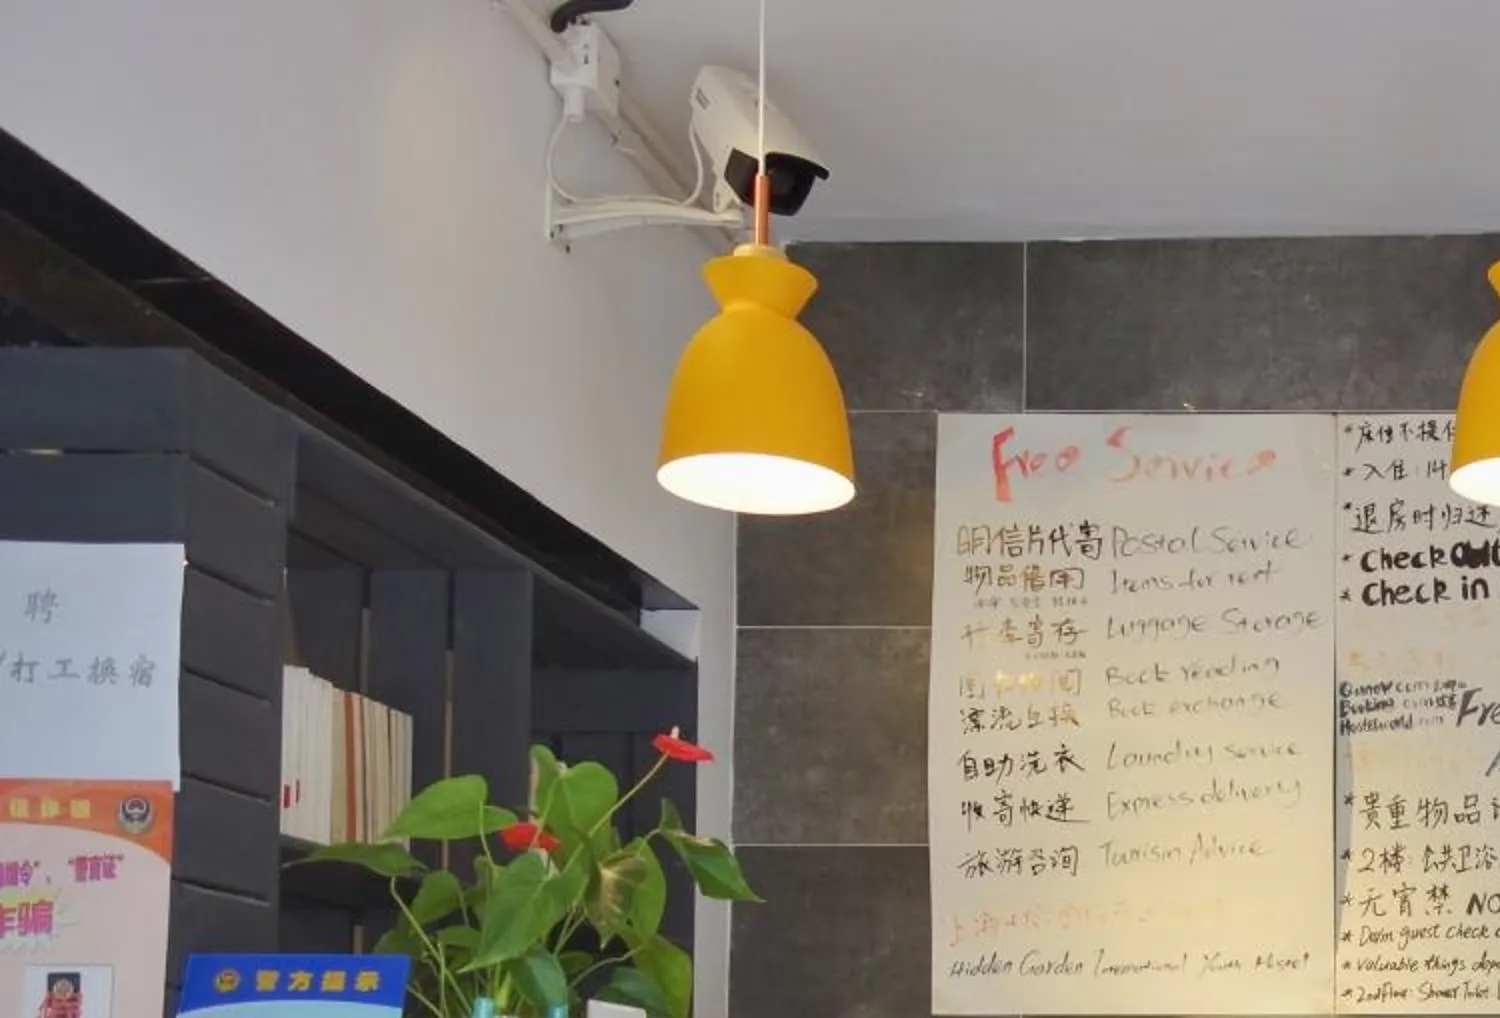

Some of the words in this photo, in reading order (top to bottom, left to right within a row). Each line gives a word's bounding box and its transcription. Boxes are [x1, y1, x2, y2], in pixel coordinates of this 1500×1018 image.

[992, 426, 1081, 502] Free
[1461, 576, 1490, 600] in
[957, 744, 1086, 784] 自助洗衣
[1398, 924, 1440, 951] guest
